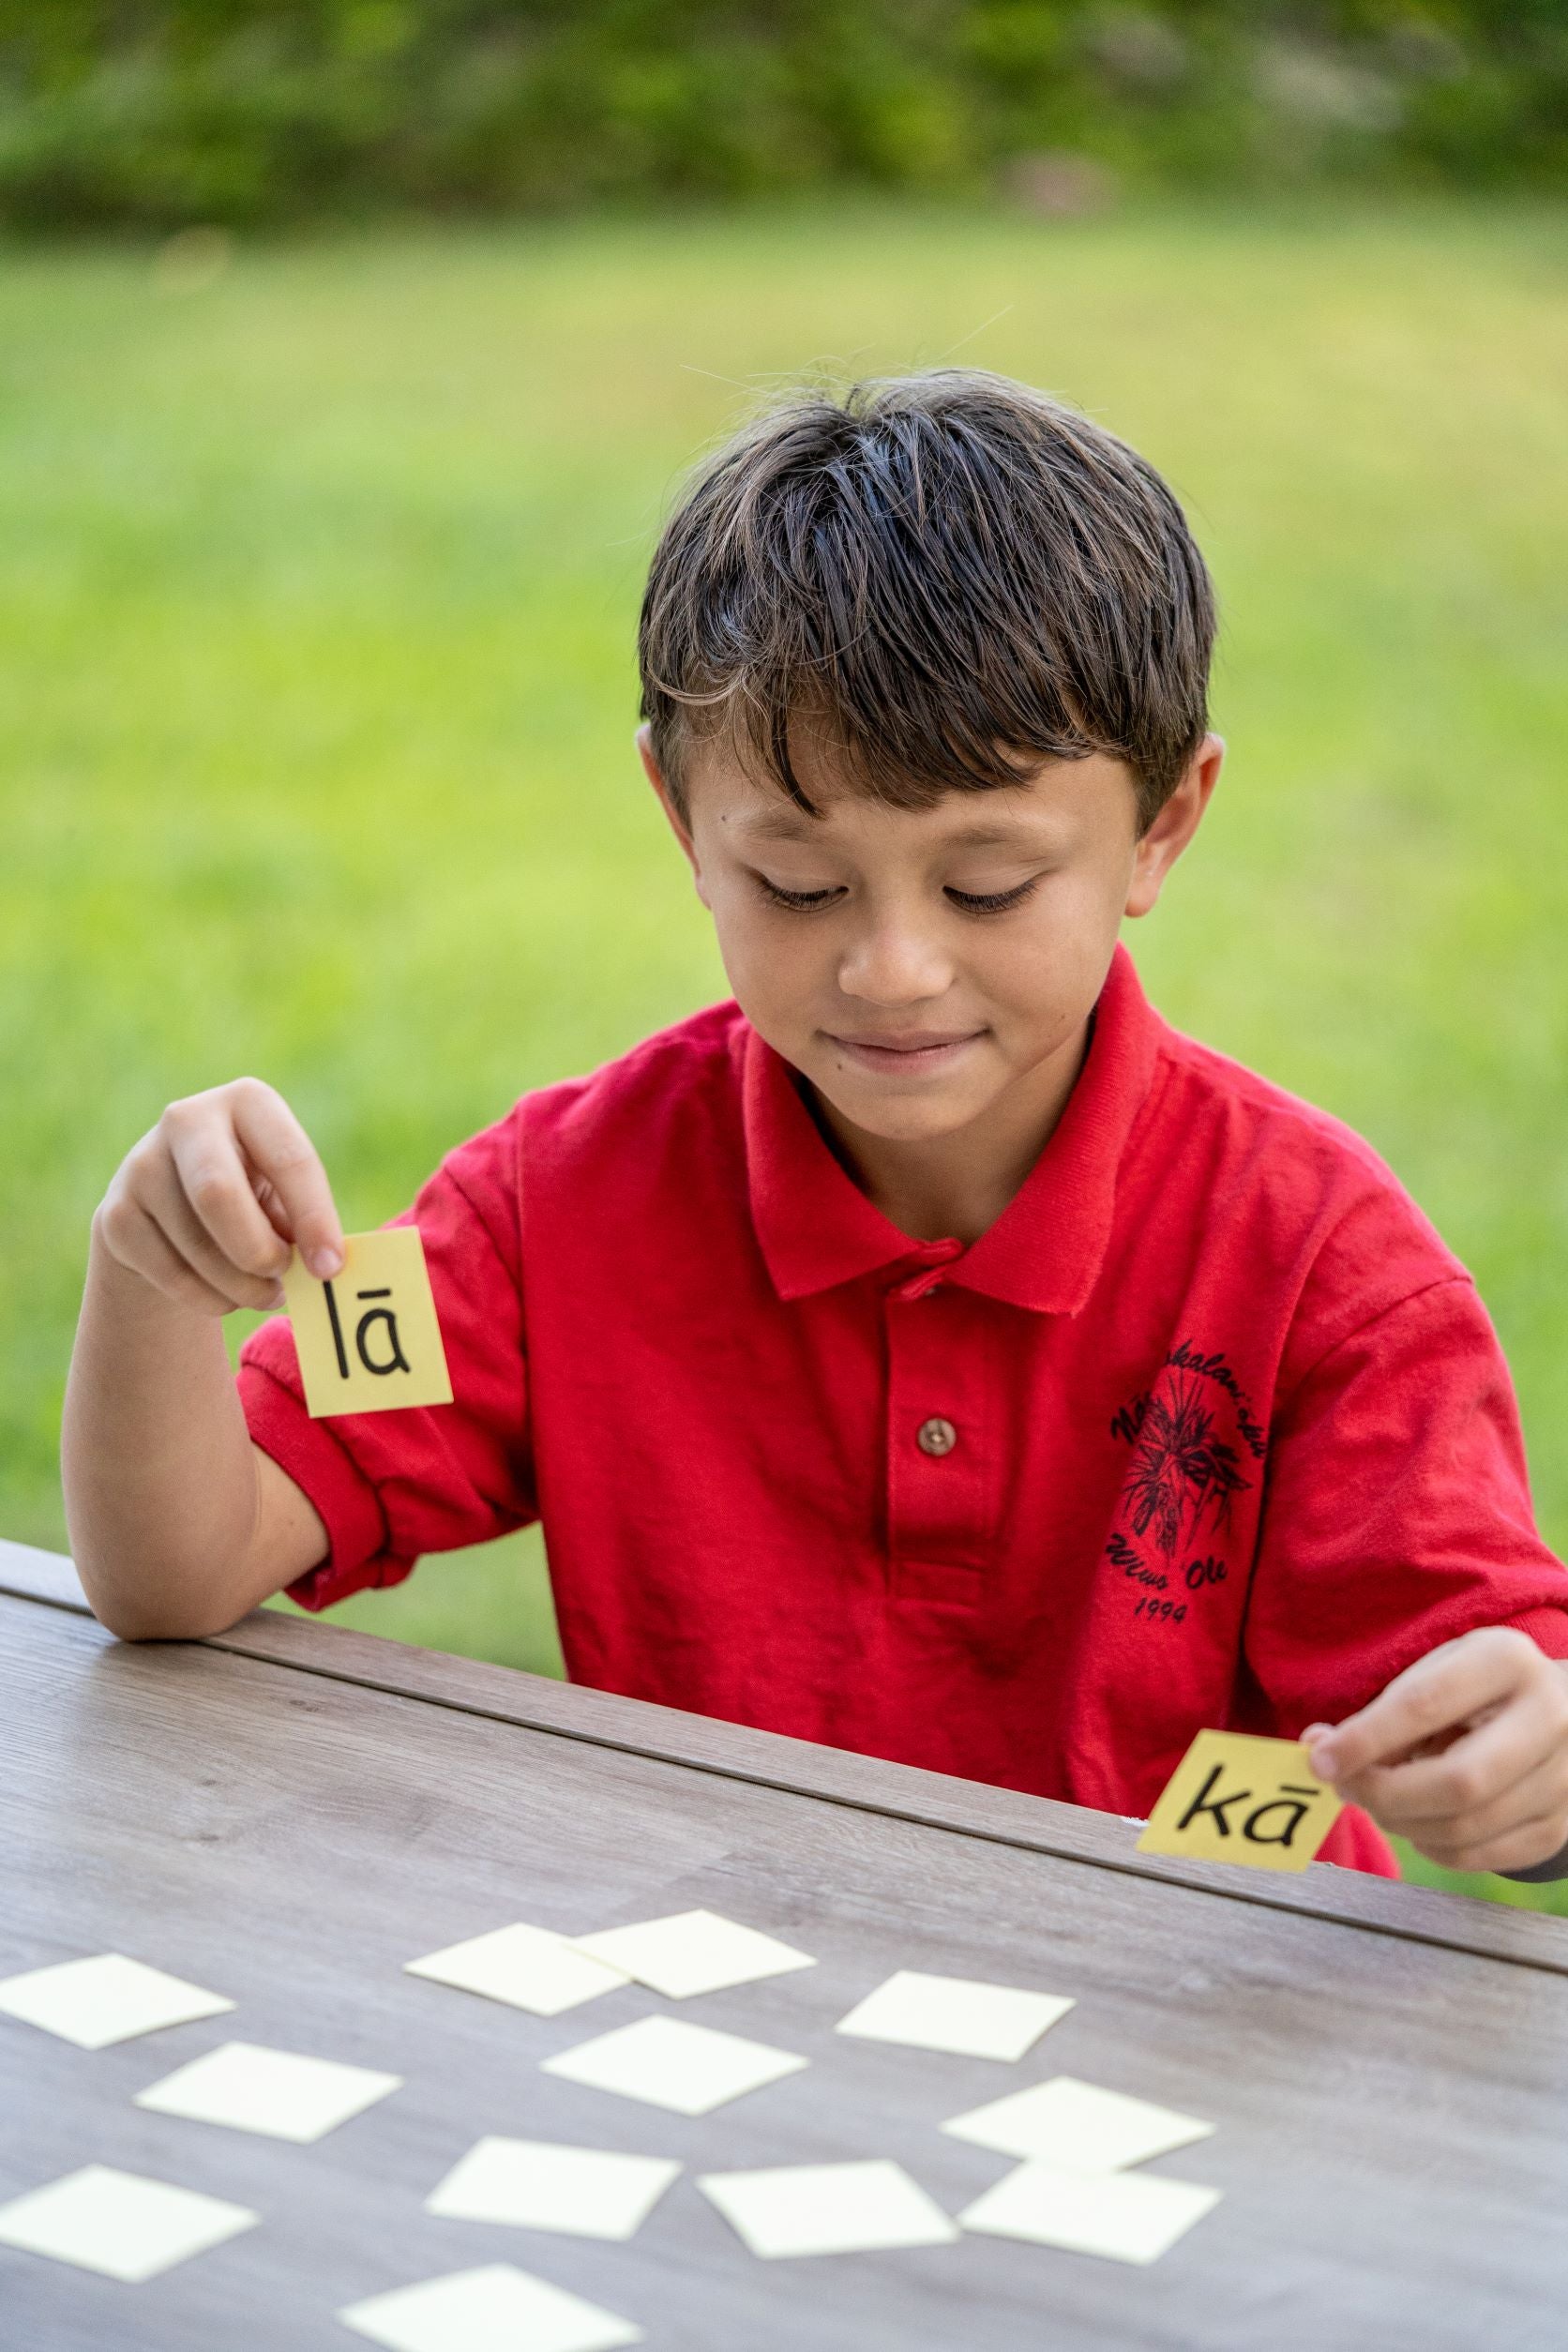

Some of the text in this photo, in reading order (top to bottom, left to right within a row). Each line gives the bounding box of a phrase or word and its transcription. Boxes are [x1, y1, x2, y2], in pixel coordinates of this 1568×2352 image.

[323, 1279, 411, 1380] lā
[1135, 1597, 1187, 1623] 1994
[1177, 1763, 1319, 1847] kā
